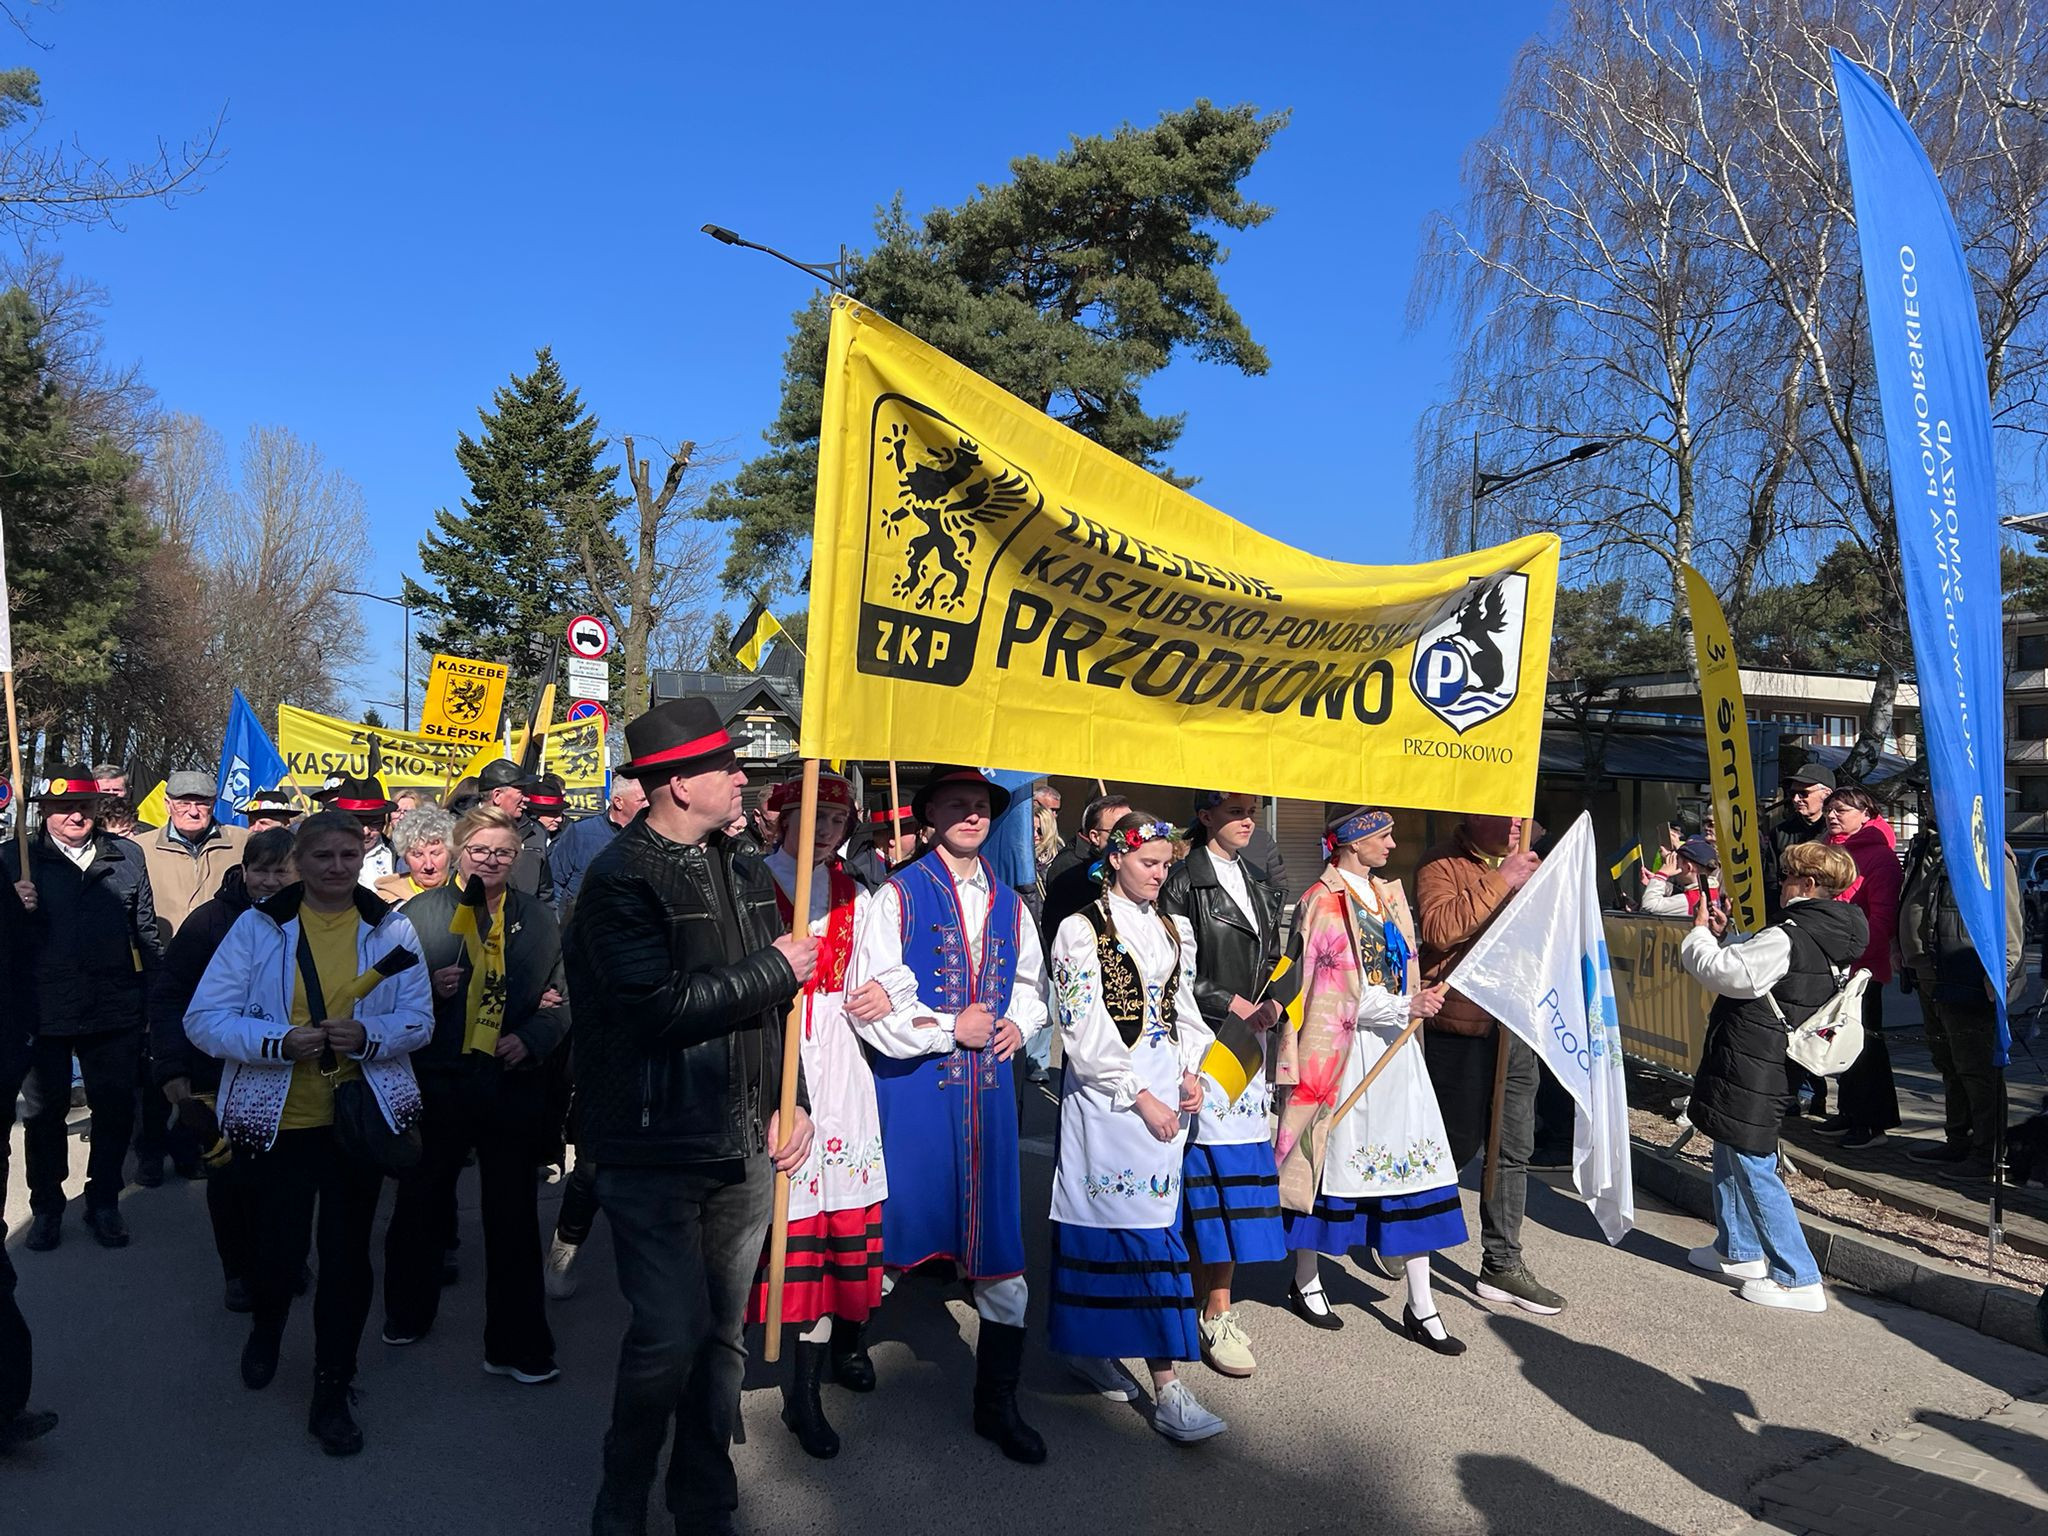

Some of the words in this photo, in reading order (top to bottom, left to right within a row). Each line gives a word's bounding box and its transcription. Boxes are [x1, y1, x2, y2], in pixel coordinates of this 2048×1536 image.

[1054, 505, 1283, 602] ZRZESZENIE
[876, 619, 951, 669] ZKP
[996, 588, 1394, 726] PRZODKOWO
[1426, 649, 1464, 699] P
[1403, 738, 1513, 764] PRZODKOWO
